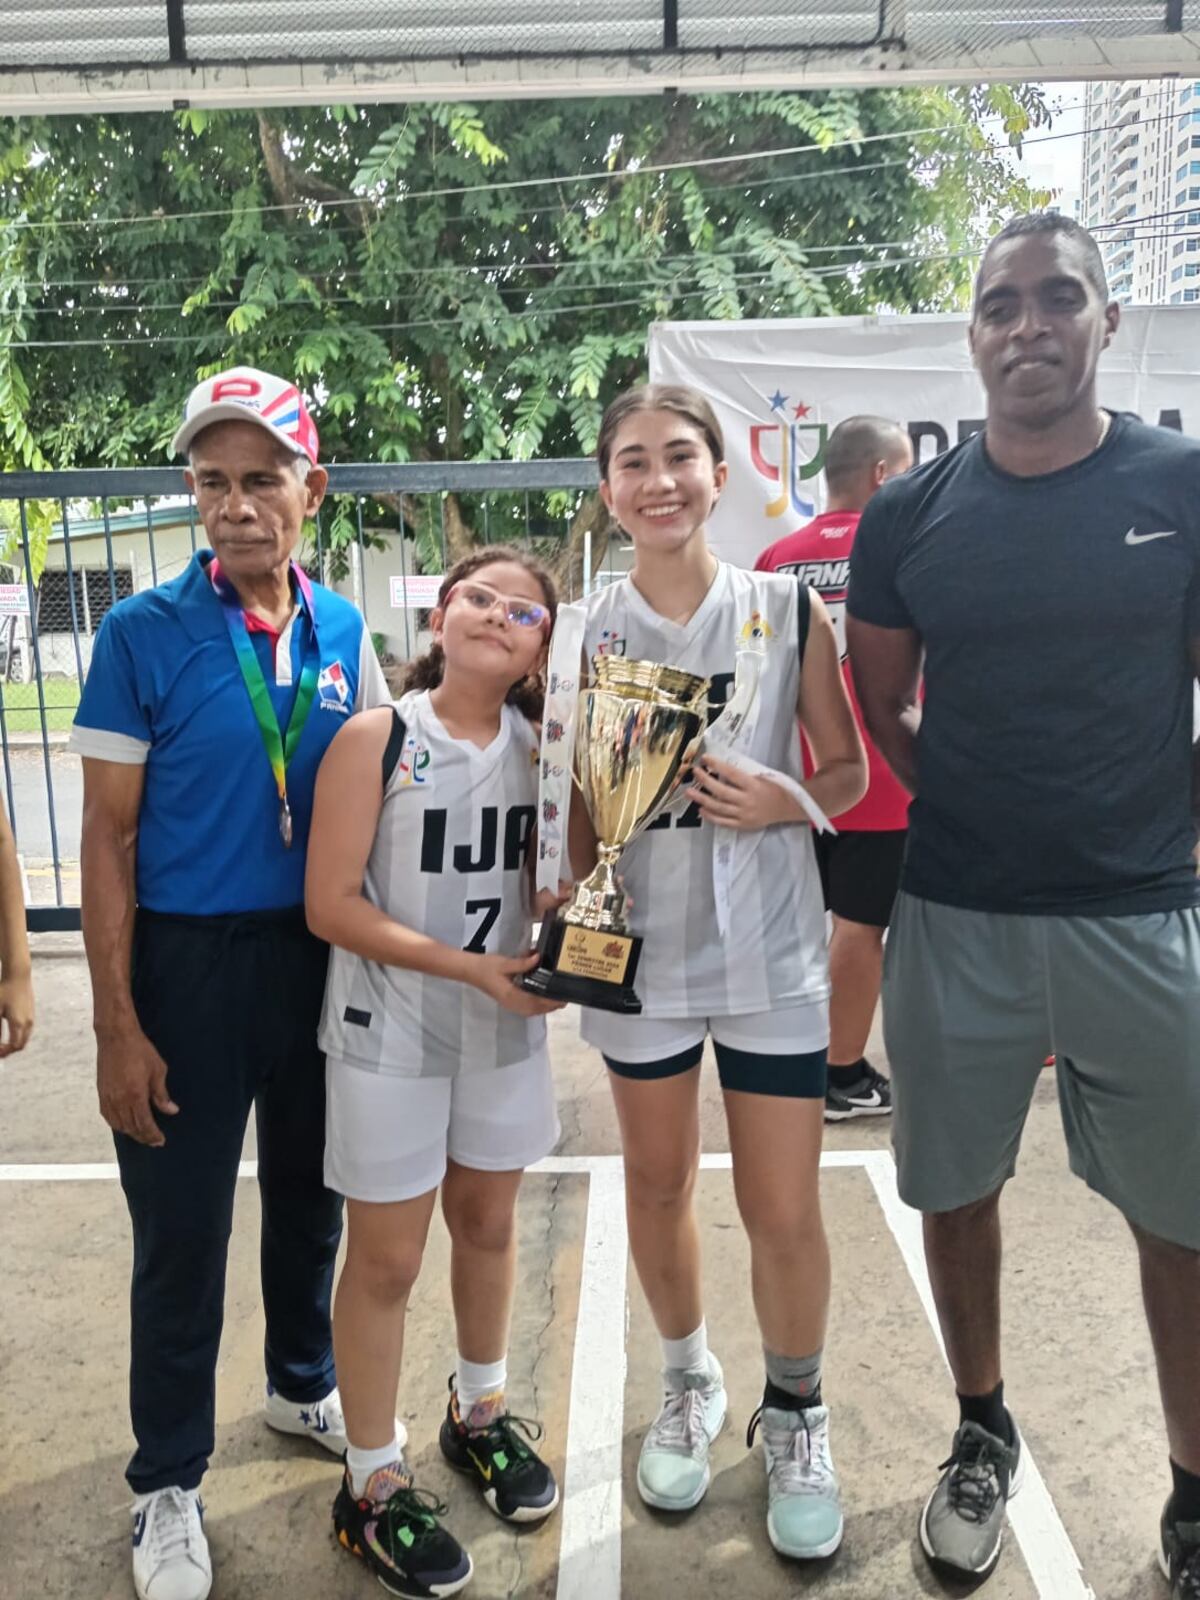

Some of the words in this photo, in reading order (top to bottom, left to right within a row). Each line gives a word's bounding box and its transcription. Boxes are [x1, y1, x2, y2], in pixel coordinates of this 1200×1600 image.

[211, 378, 262, 403] P
[420, 805, 537, 874] IJA
[462, 897, 502, 954] 7
